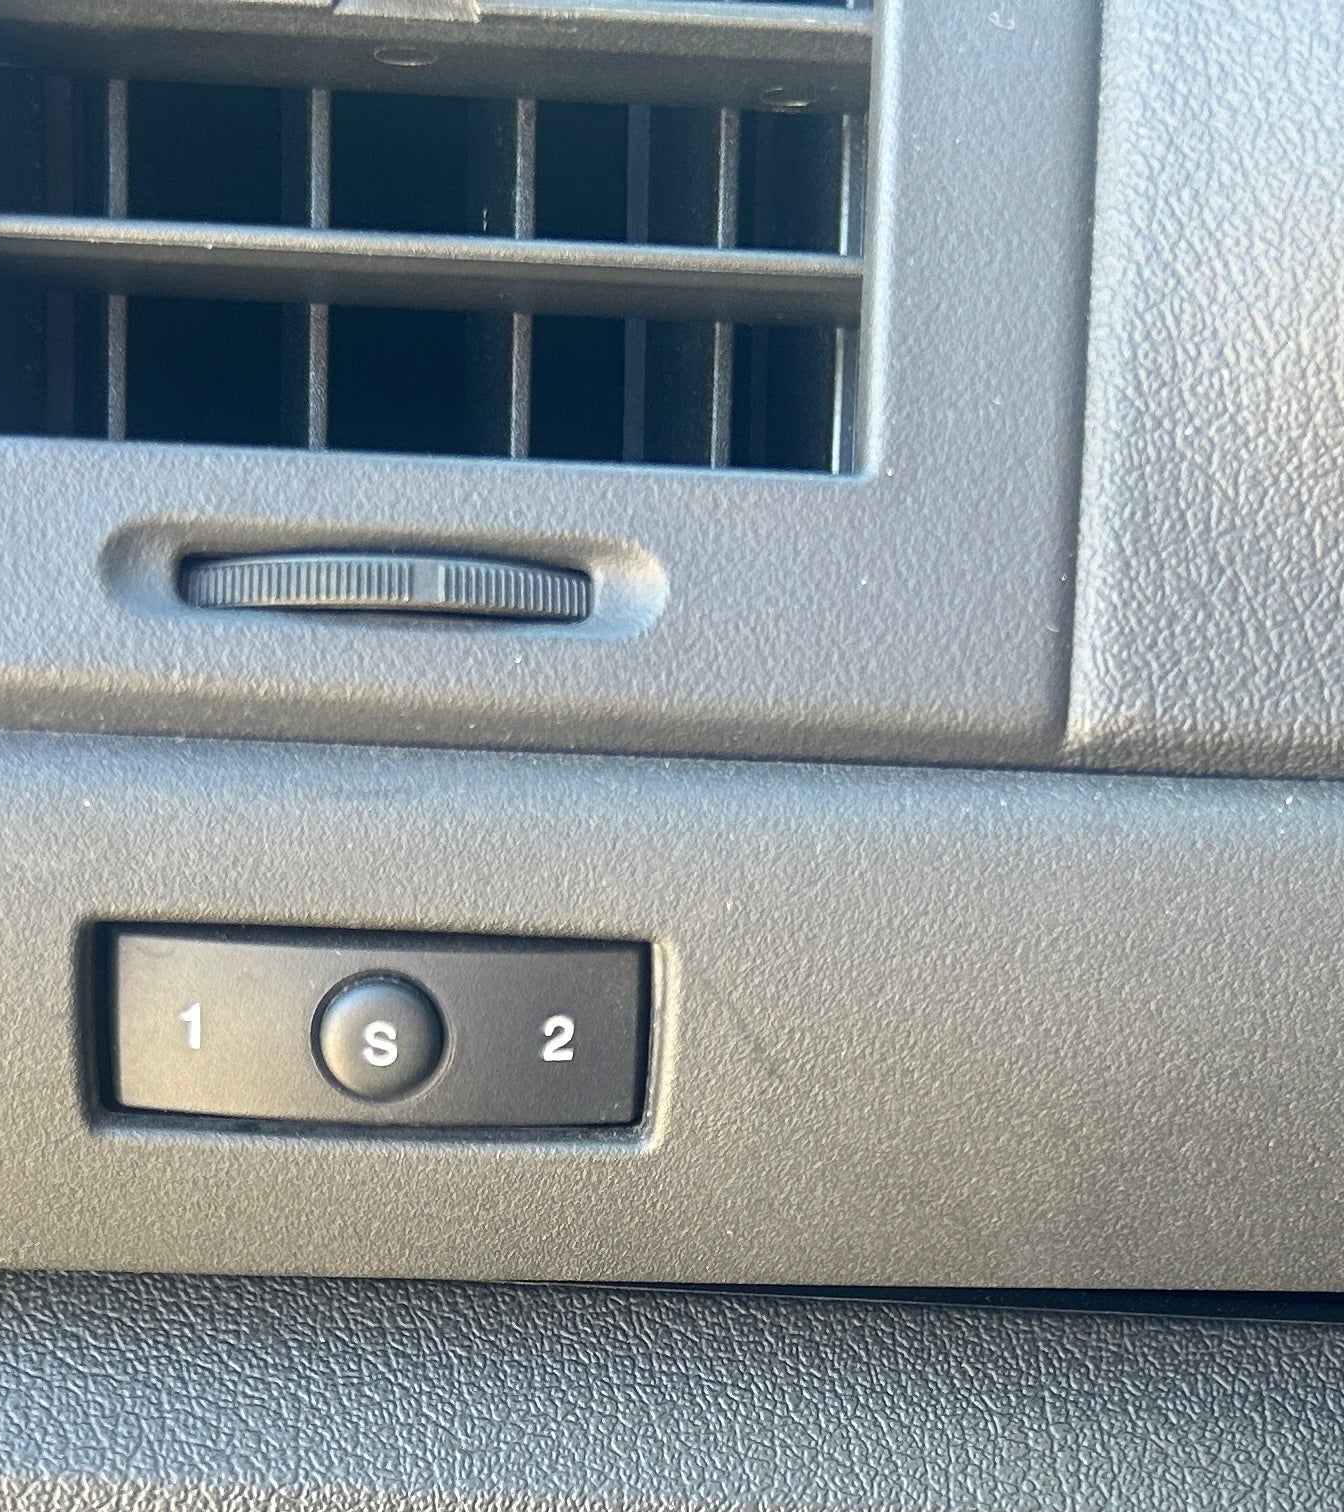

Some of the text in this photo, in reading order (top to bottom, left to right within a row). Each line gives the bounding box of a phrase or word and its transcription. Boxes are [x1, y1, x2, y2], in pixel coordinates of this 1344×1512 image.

[177, 1001, 203, 1050] 1
[362, 1020, 399, 1068] S
[541, 1014, 576, 1063] 2
